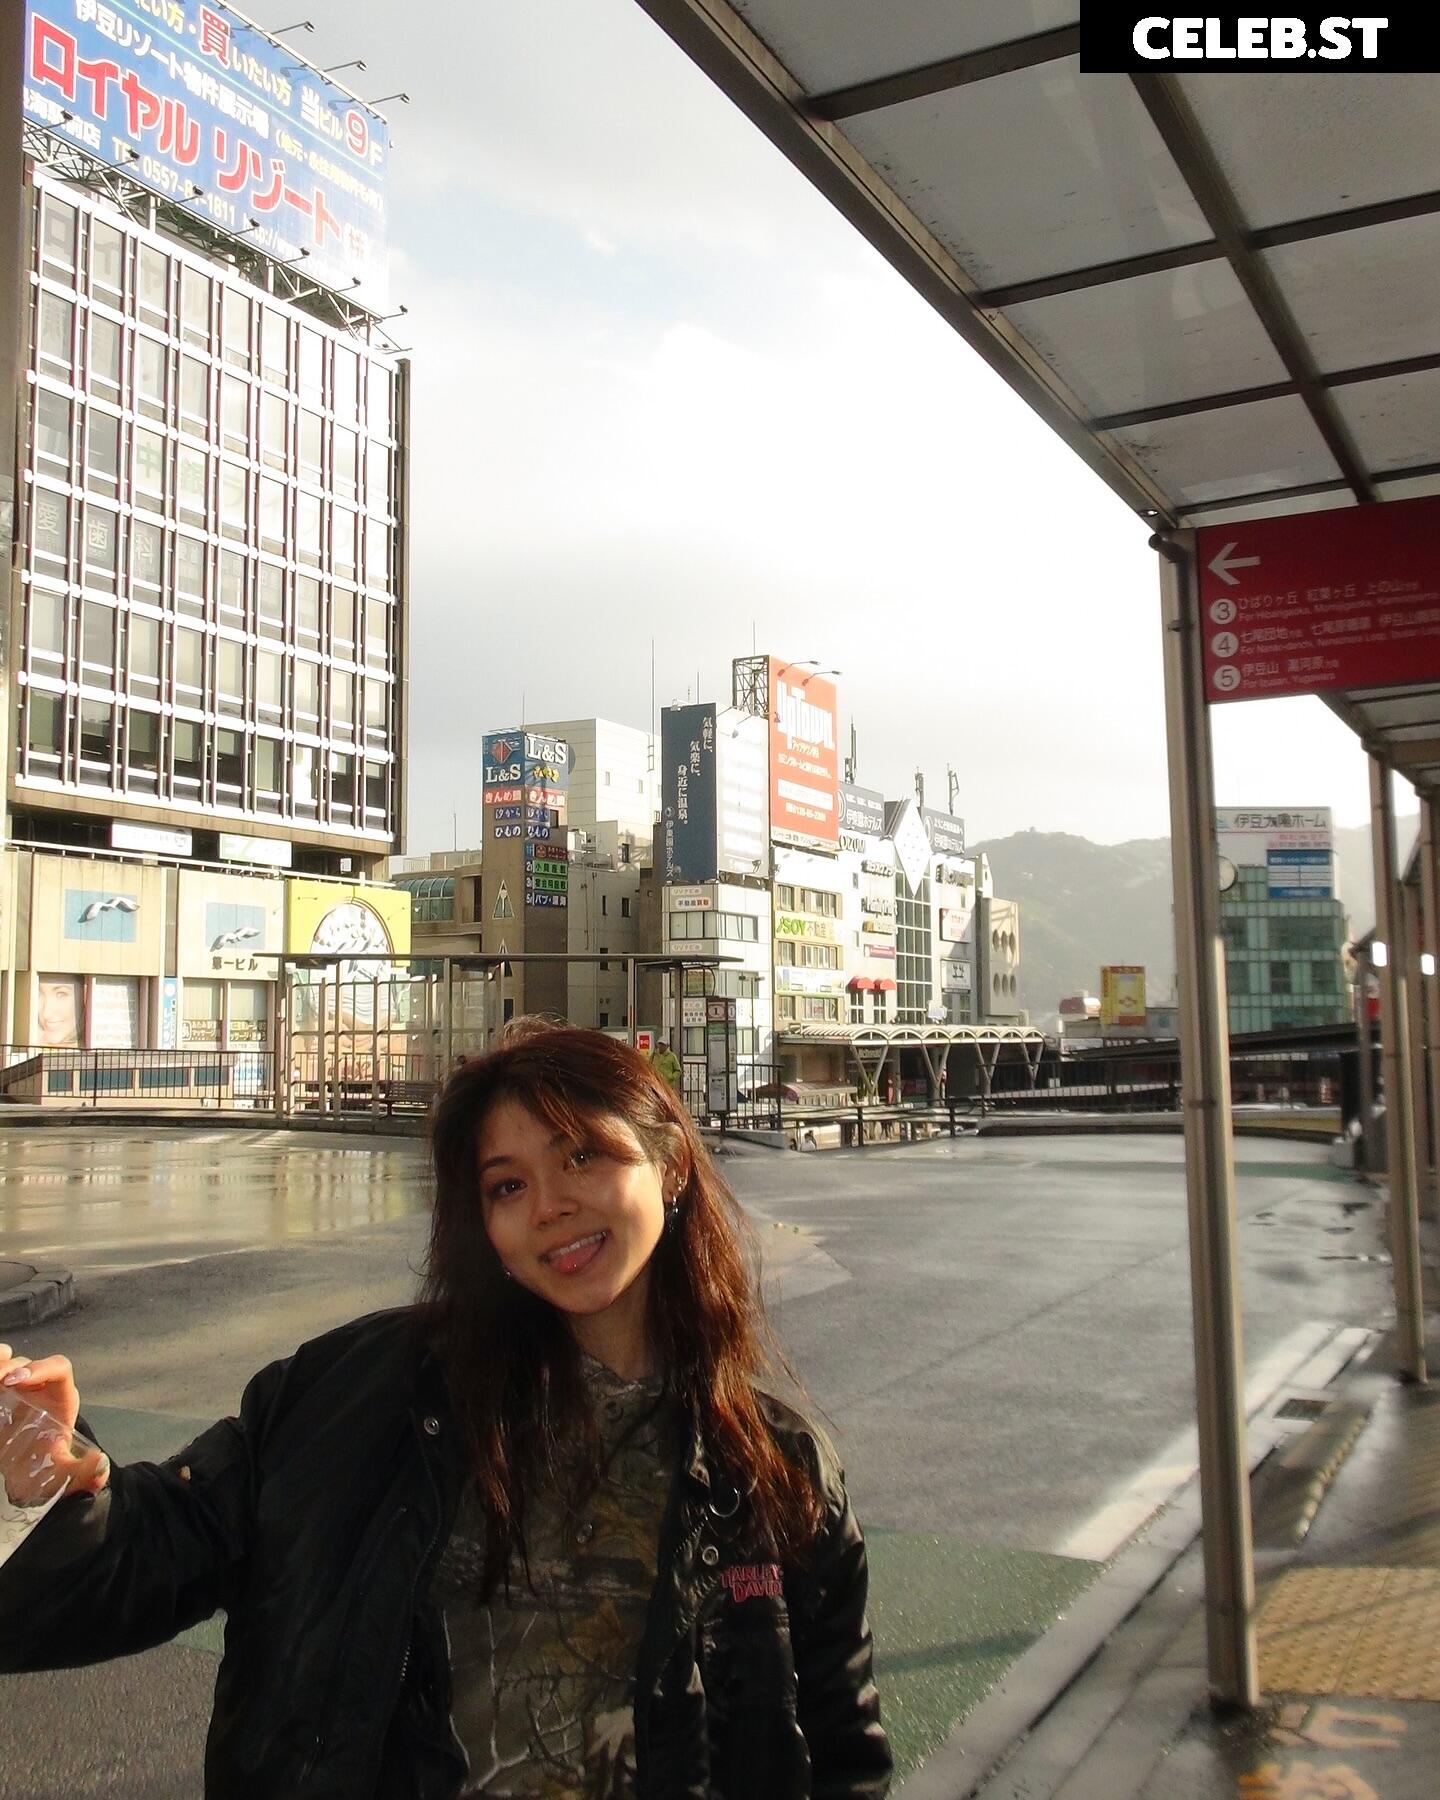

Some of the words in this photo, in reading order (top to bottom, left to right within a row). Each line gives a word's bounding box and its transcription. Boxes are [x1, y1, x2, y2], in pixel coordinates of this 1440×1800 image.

[31, 12, 201, 165] ロイヤル
[1217, 602, 1230, 620] 3
[1218, 636, 1231, 653] 4
[1221, 668, 1233, 687] 5
[527, 736, 566, 764] L&S
[485, 764, 521, 783] L&S
[495, 826, 521, 838] ひもの
[527, 826, 549, 838] ひもの
[211, 956, 258, 972] 第一ビル
